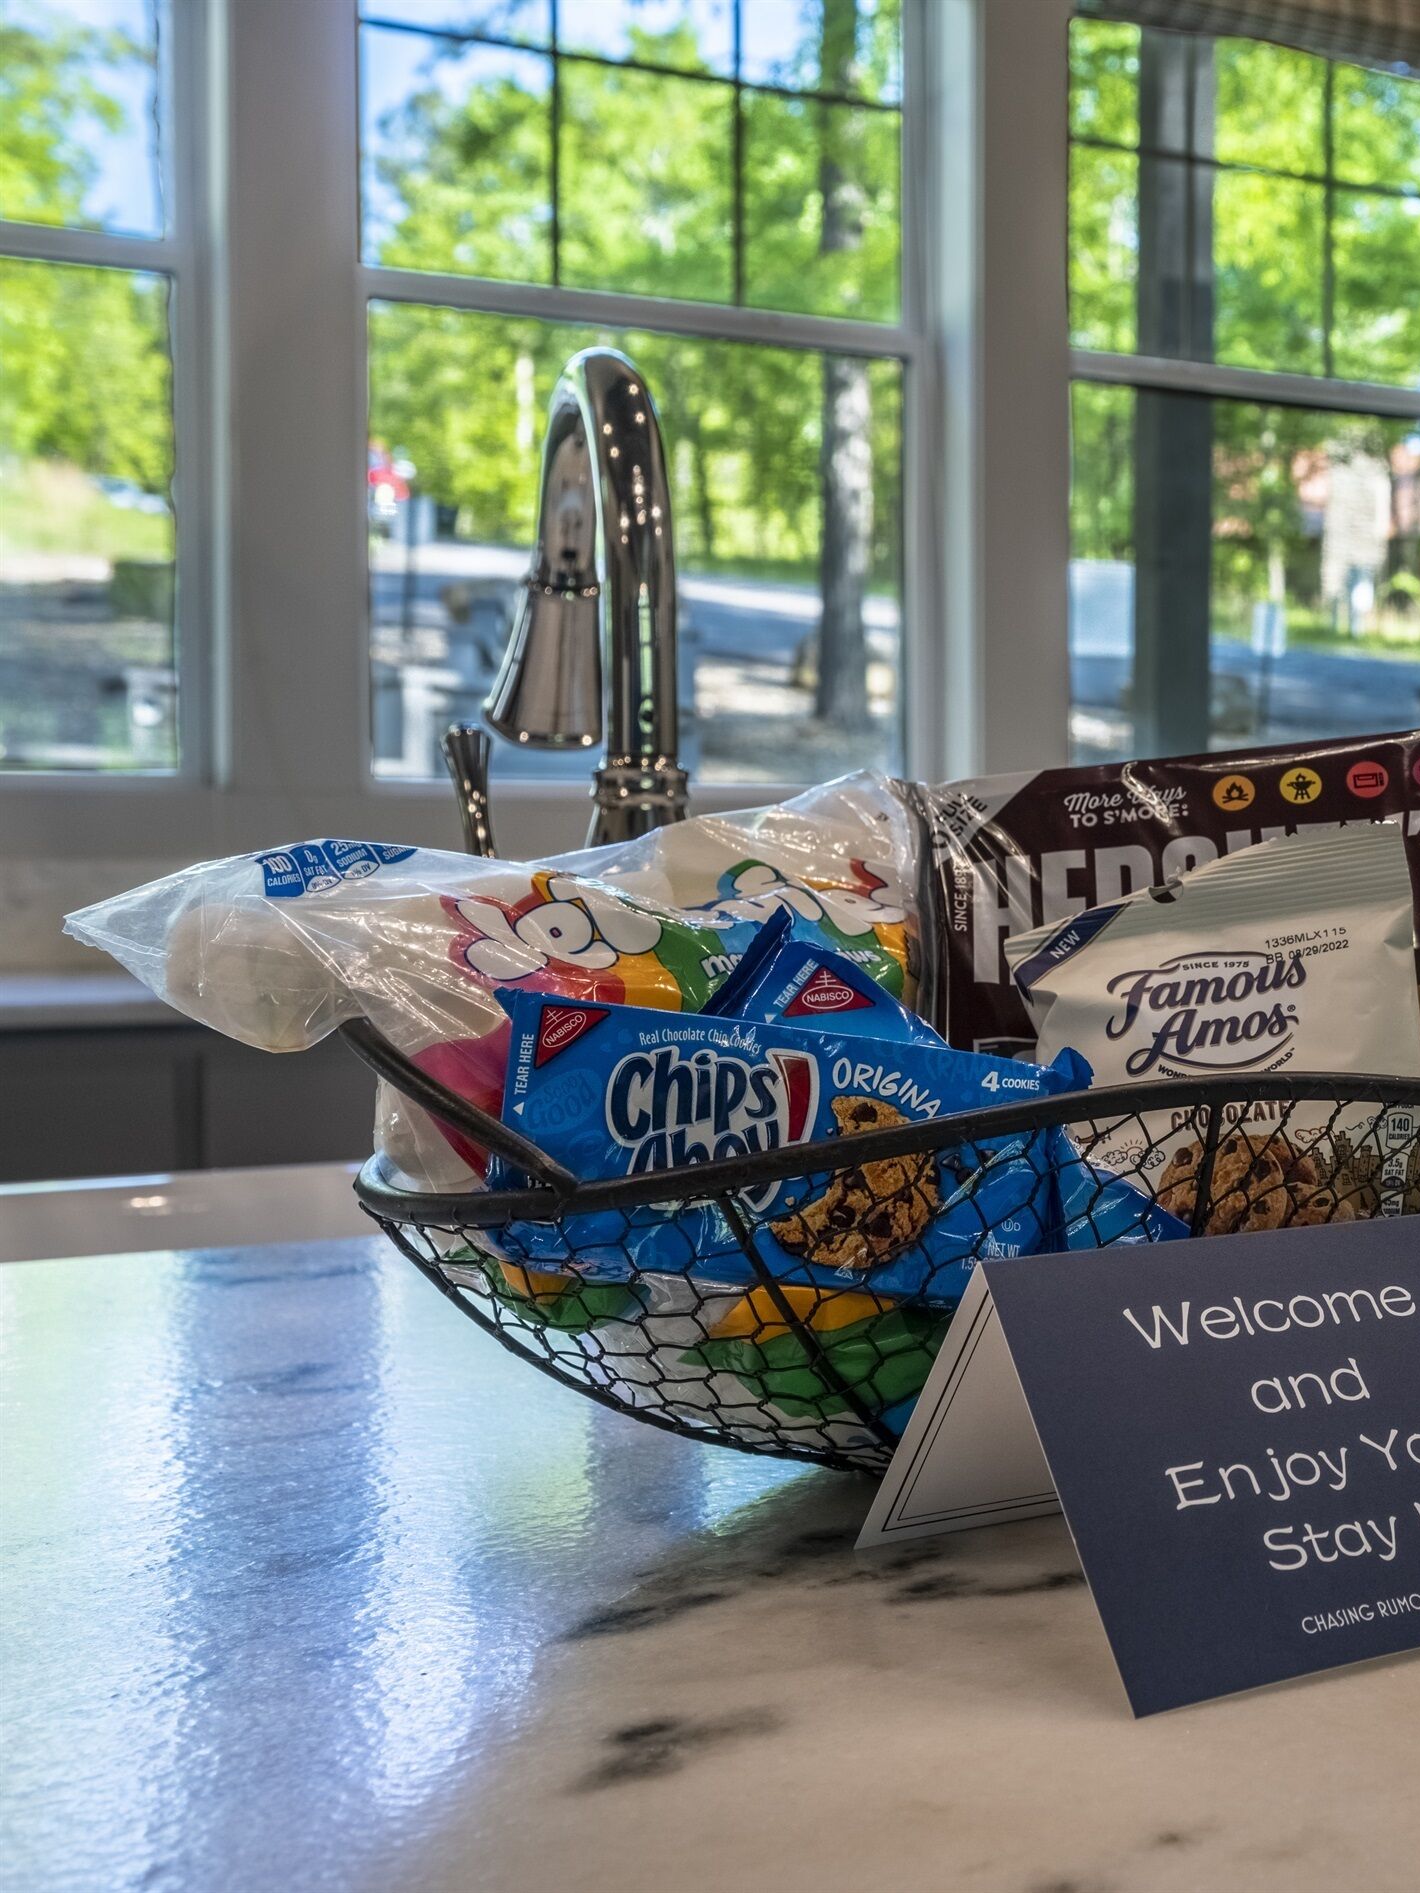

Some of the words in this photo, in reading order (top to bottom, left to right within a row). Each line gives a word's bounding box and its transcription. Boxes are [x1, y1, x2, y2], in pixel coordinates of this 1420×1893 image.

[1064, 792, 1123, 813] More
[1070, 813, 1097, 828] TO
[1103, 804, 1188, 824] S'MOE:
[263, 855, 292, 874] 100
[304, 850, 318, 863] 0g
[337, 848, 368, 868] SODIUM
[267, 874, 301, 886] CALORIES
[304, 867, 315, 876] SAT
[316, 865, 328, 875] FAT
[362, 865, 371, 874] DV
[955, 893, 967, 931] SINCE
[1050, 930, 1081, 960] NEW
[1265, 927, 1346, 949] 1336MLX115
[1182, 961, 1219, 971] SINCE
[1265, 953, 1283, 965] BB
[773, 981, 798, 1008] TEAR
[796, 958, 819, 987] HERE
[807, 990, 850, 1003] NABISCO
[1106, 953, 1306, 1040] Famous
[546, 1015, 583, 1045] NABISCO
[639, 1030, 660, 1046] Real
[661, 1027, 706, 1043] Chocolate
[519, 1033, 534, 1063] HERE
[514, 1066, 530, 1095] TEAR
[832, 1057, 941, 1118] ORIGINA
[981, 1071, 999, 1092] 4
[1002, 1077, 1039, 1091] COOKIES
[609, 1049, 781, 1140] Chips
[1171, 1100, 1294, 1131] CHOOLATE
[1391, 1118, 1409, 1131] 140
[987, 1242, 1004, 1258] NET
[1007, 1244, 1020, 1258] WT
[1123, 1284, 1416, 1349] Welcome
[1250, 1357, 1371, 1414] and
[1165, 1446, 1349, 1511] Enjoy
[1262, 1514, 1398, 1572] Stay
[1302, 1604, 1375, 1634] CHASING
